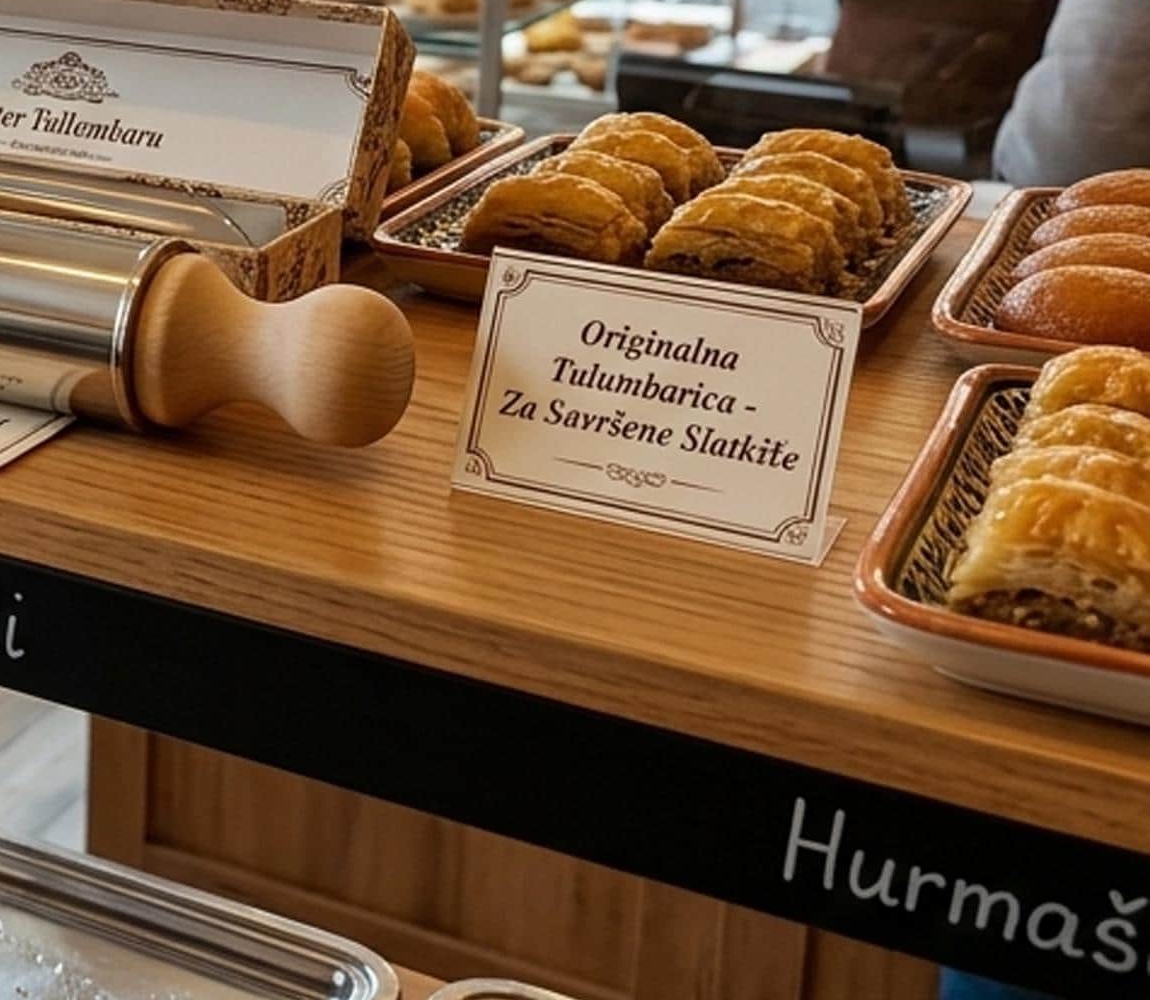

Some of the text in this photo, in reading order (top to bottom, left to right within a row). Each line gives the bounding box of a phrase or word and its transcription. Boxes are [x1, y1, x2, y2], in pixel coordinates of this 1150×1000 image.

[581, 319, 740, 372] Originalna
[551, 356, 738, 415] Tulumbarica
[499, 390, 538, 422] Za
[543, 399, 673, 448] Savršene
